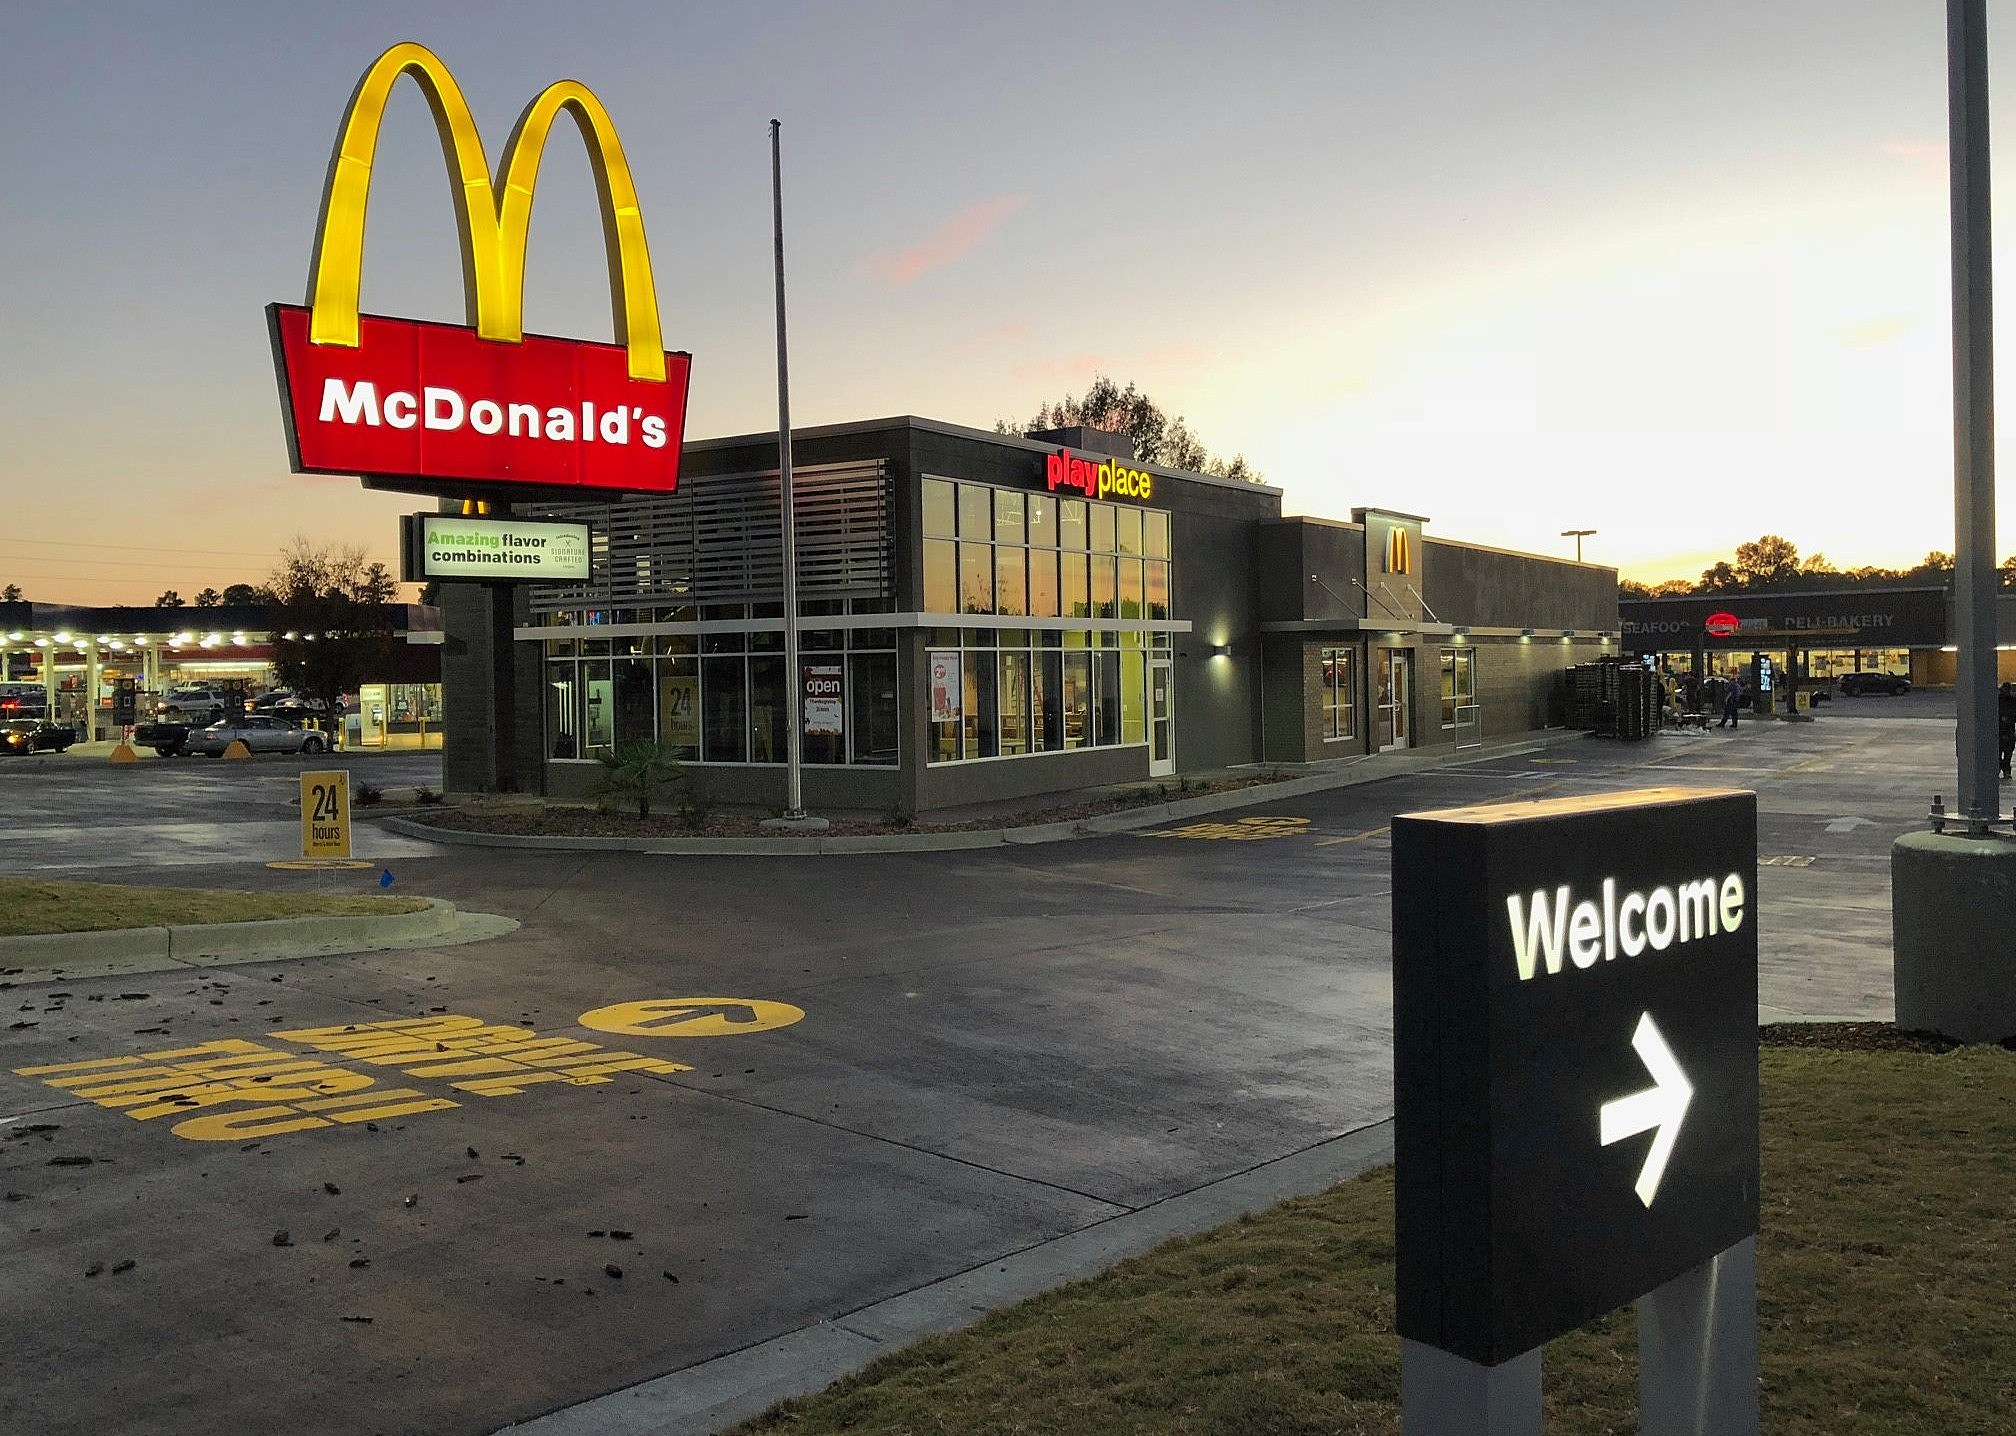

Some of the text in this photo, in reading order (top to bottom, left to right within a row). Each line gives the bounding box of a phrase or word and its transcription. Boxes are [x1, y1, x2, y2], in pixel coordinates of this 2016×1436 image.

[318, 378, 668, 449] McDonald's
[428, 531, 547, 549] Amazing flavor
[432, 550, 541, 564] combinations
[670, 687, 691, 716] 24
[806, 680, 840, 696] open
[311, 784, 339, 821] 24
[312, 823, 340, 840] hours
[1506, 871, 1745, 982] Welcome
[265, 1014, 695, 1097] DRIVE
[11, 1038, 463, 1141] THRU
